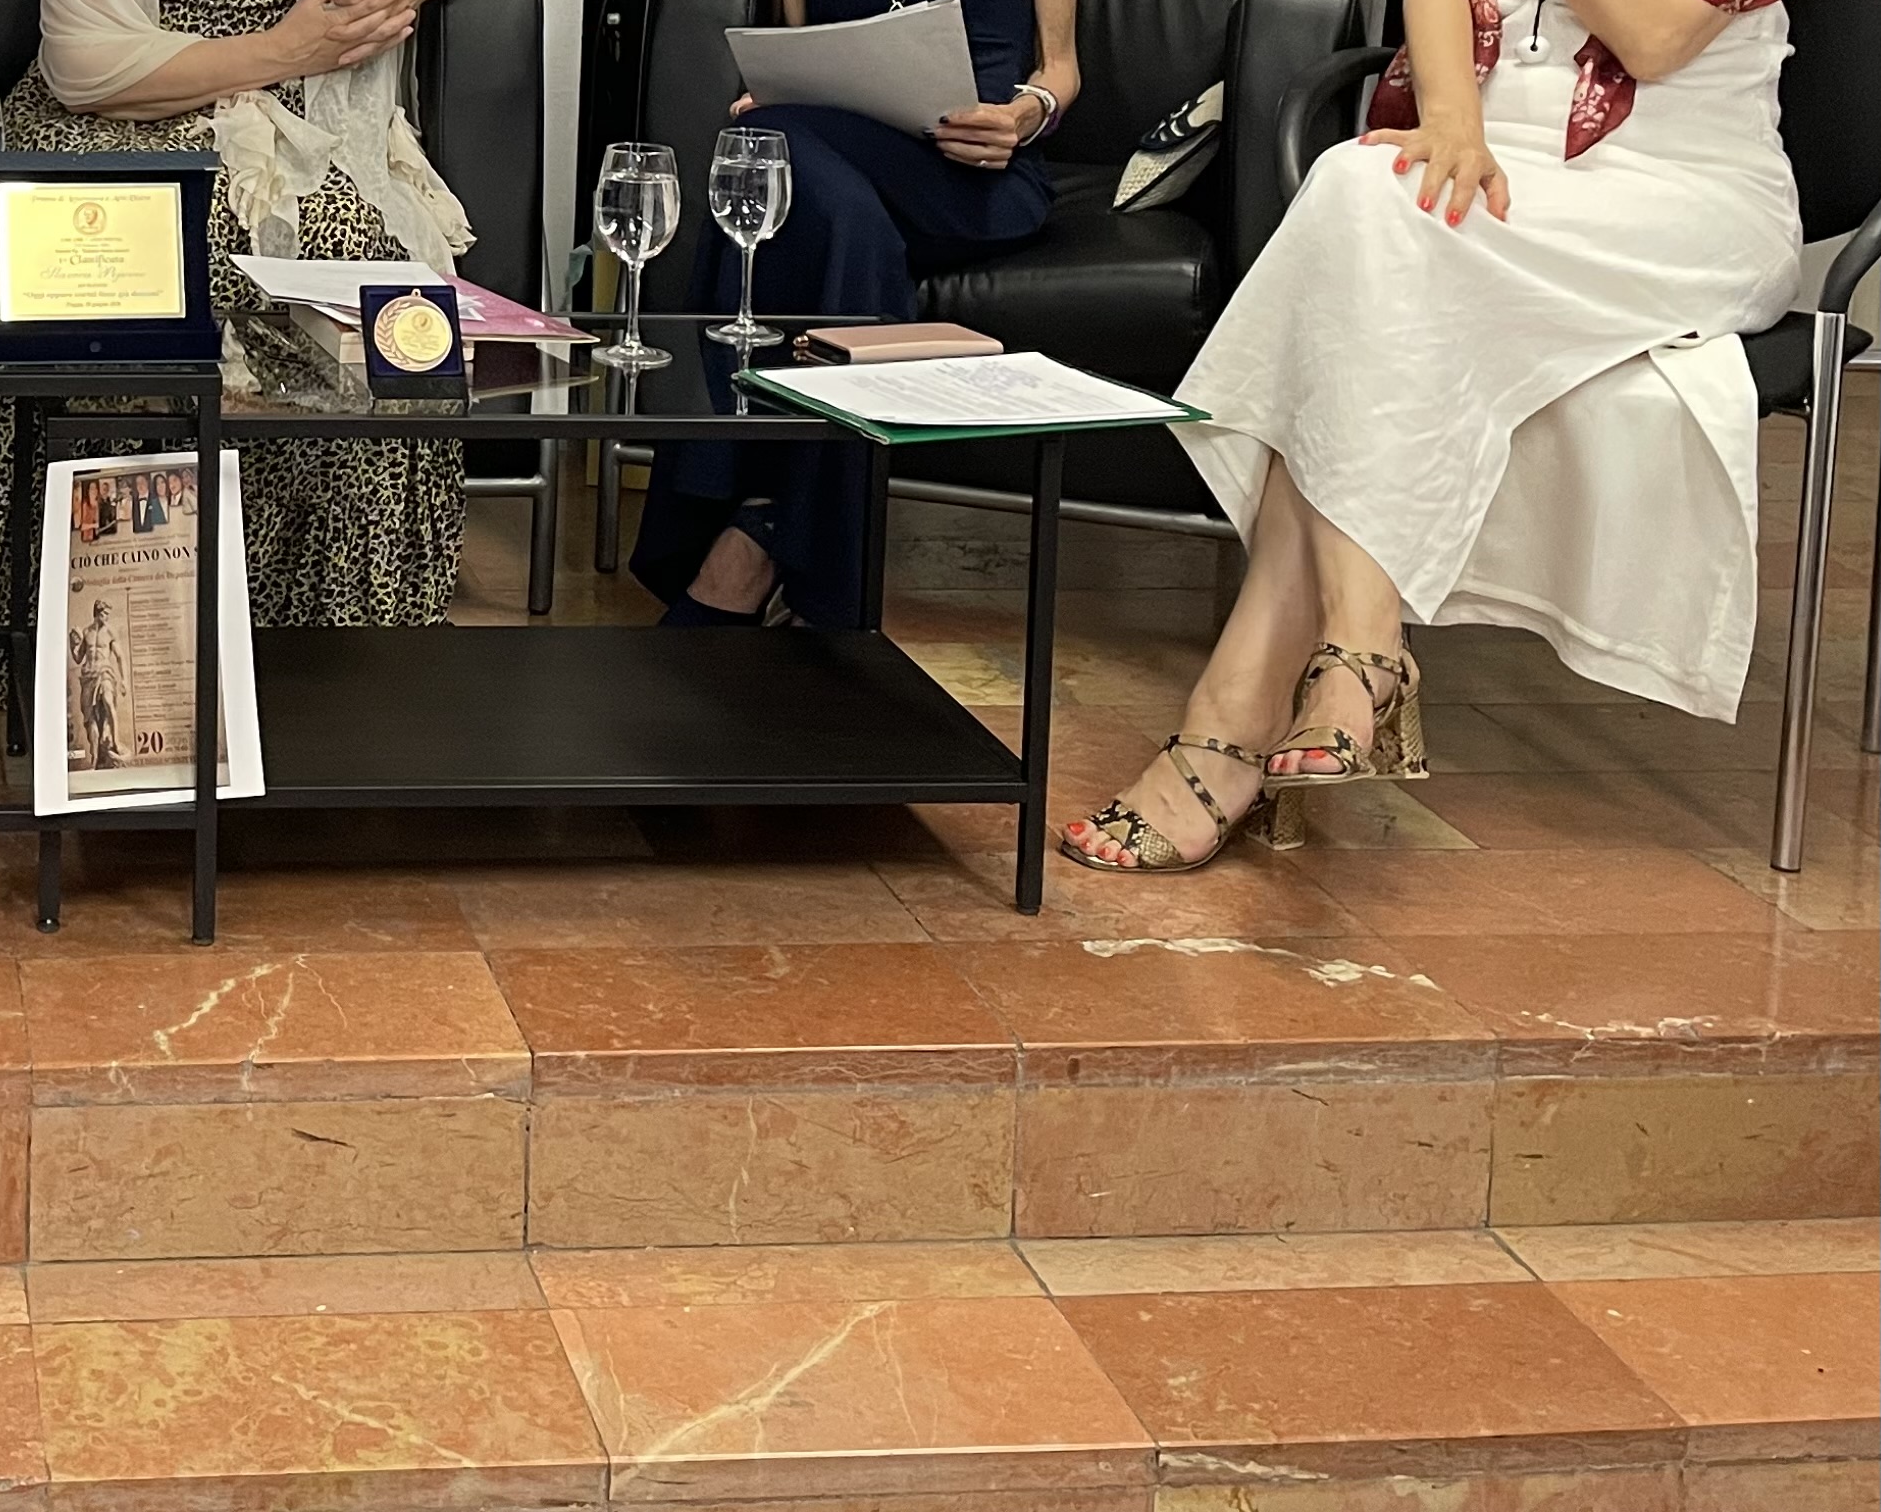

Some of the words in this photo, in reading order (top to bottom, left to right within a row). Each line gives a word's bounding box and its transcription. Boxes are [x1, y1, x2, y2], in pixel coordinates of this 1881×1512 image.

[71, 553, 91, 569] CIÒ
[94, 553, 119, 567] CHE
[122, 548, 159, 564] CAINO
[163, 546, 190, 560] NON
[137, 731, 164, 755] 20
